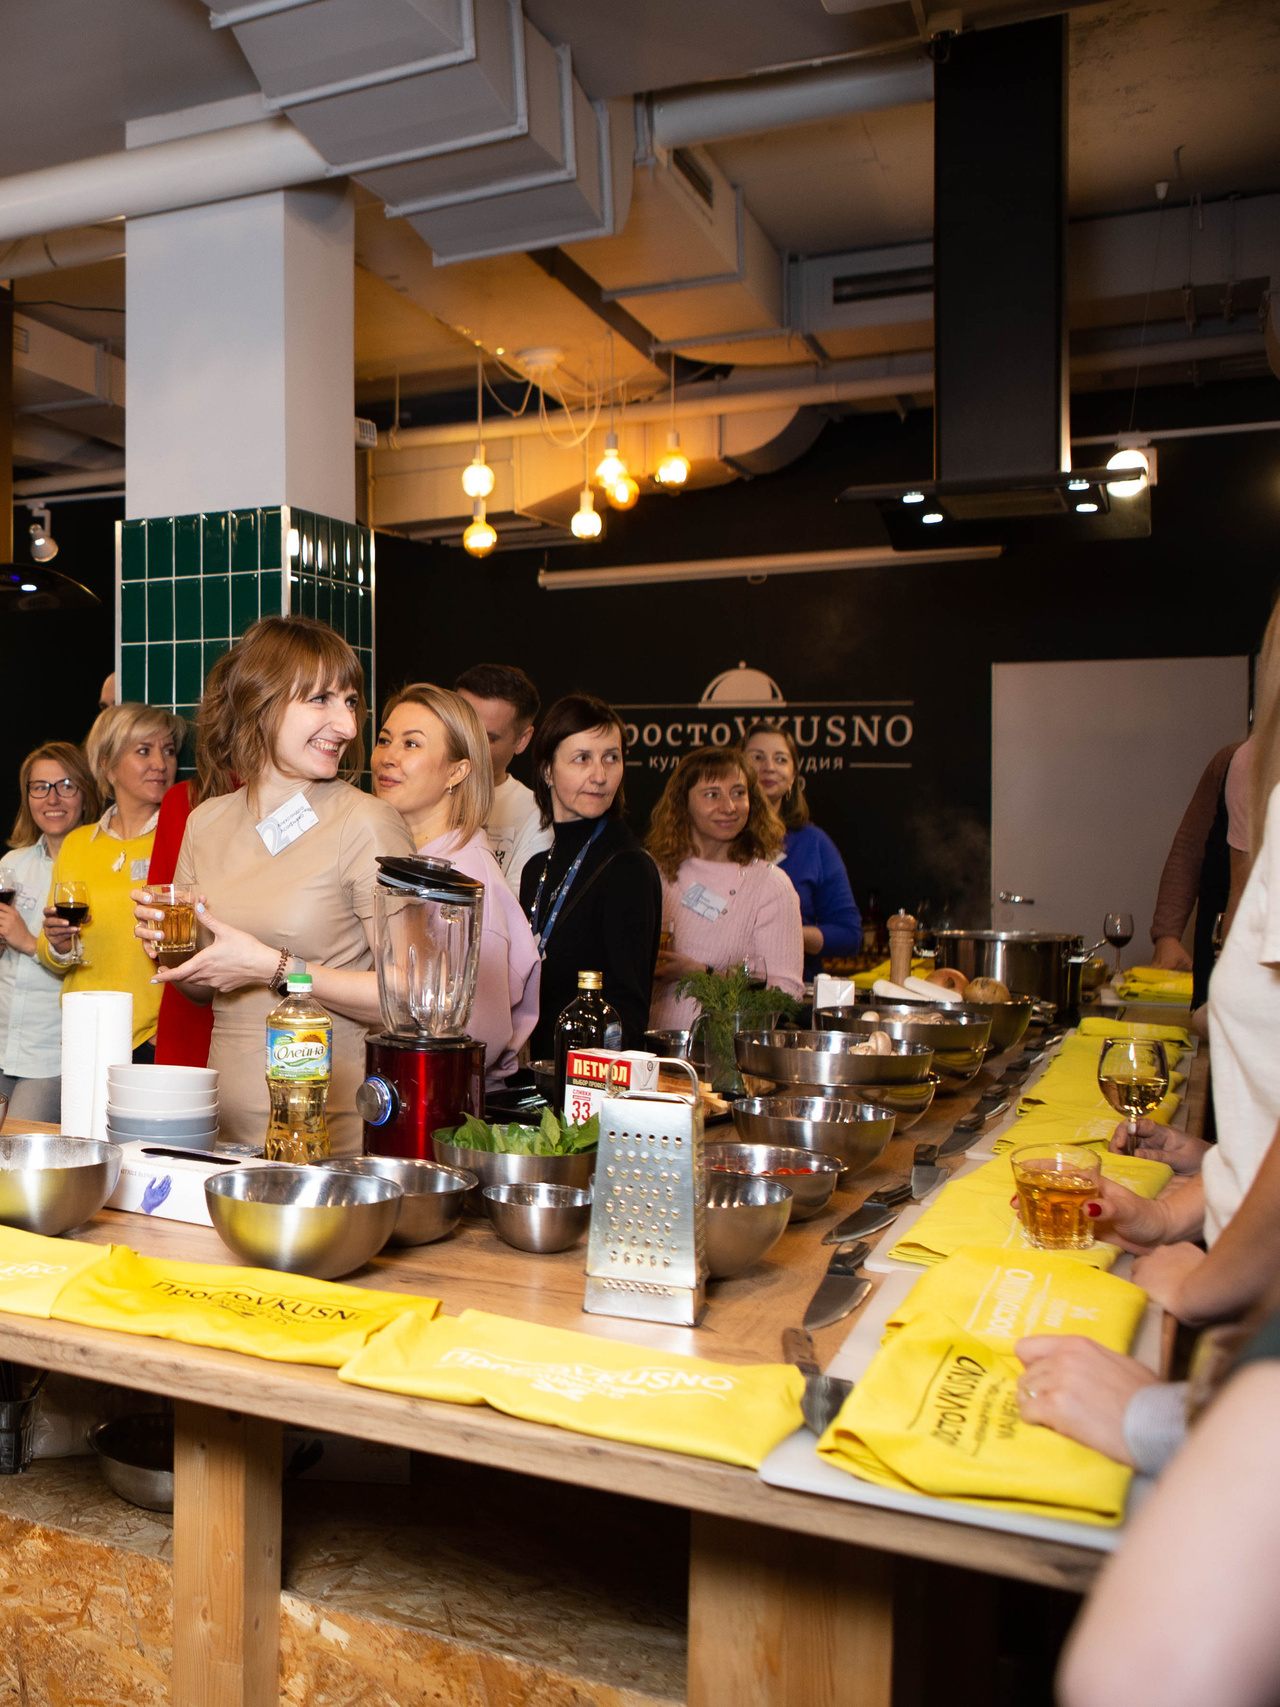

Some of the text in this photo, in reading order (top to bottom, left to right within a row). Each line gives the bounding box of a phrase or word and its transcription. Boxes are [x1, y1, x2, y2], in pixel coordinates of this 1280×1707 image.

[276, 1045, 324, 1060] Олейна
[573, 1058, 628, 1083] ПЕТМОЛ
[571, 1100, 591, 1121] 33
